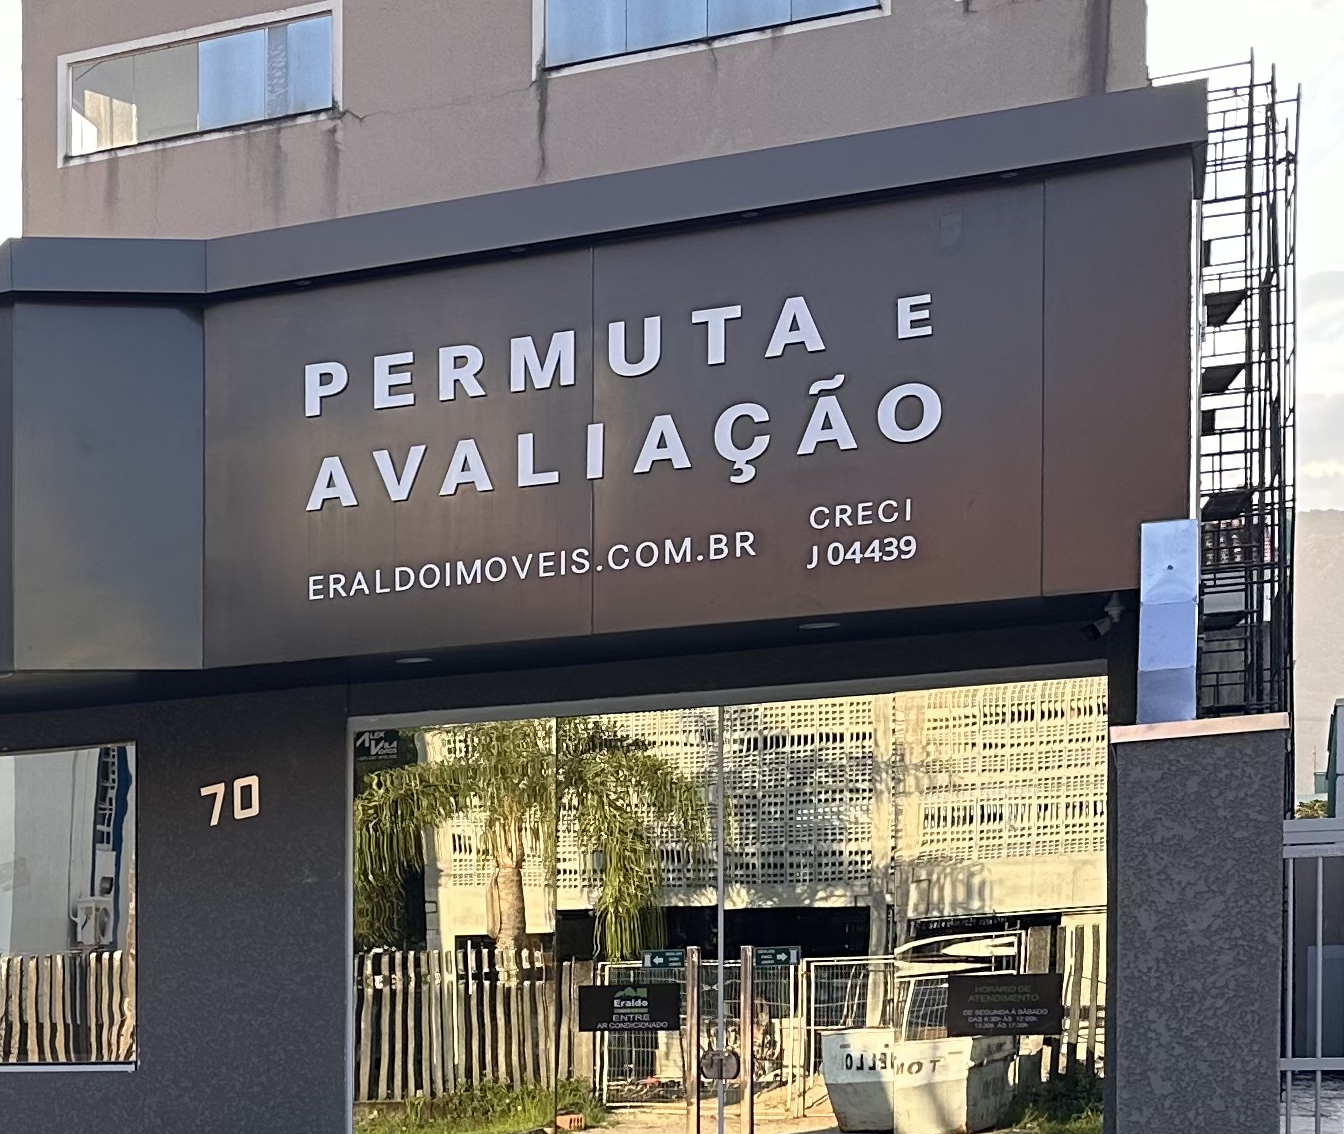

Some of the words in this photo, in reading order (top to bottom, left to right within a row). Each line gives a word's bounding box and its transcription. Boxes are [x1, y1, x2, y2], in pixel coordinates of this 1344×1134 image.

[304, 295, 826, 417] PERMUTA
[896, 293, 934, 340] E
[305, 373, 944, 512] AVALIAÇÃO
[809, 497, 913, 530] CRECI
[307, 530, 758, 600] ERALDOIMOVEIS.COM.BR
[805, 543, 820, 570] J
[826, 535, 918, 567] 04439
[200, 774, 260, 827] 70
[613, 999, 649, 1008] Eraldo
[968, 994, 1040, 1002] ATENDIMENTO
[1018, 985, 1031, 993] DE
[609, 1021, 669, 1029] CONDICIONADO
[612, 1013, 651, 1021] ENTRE
